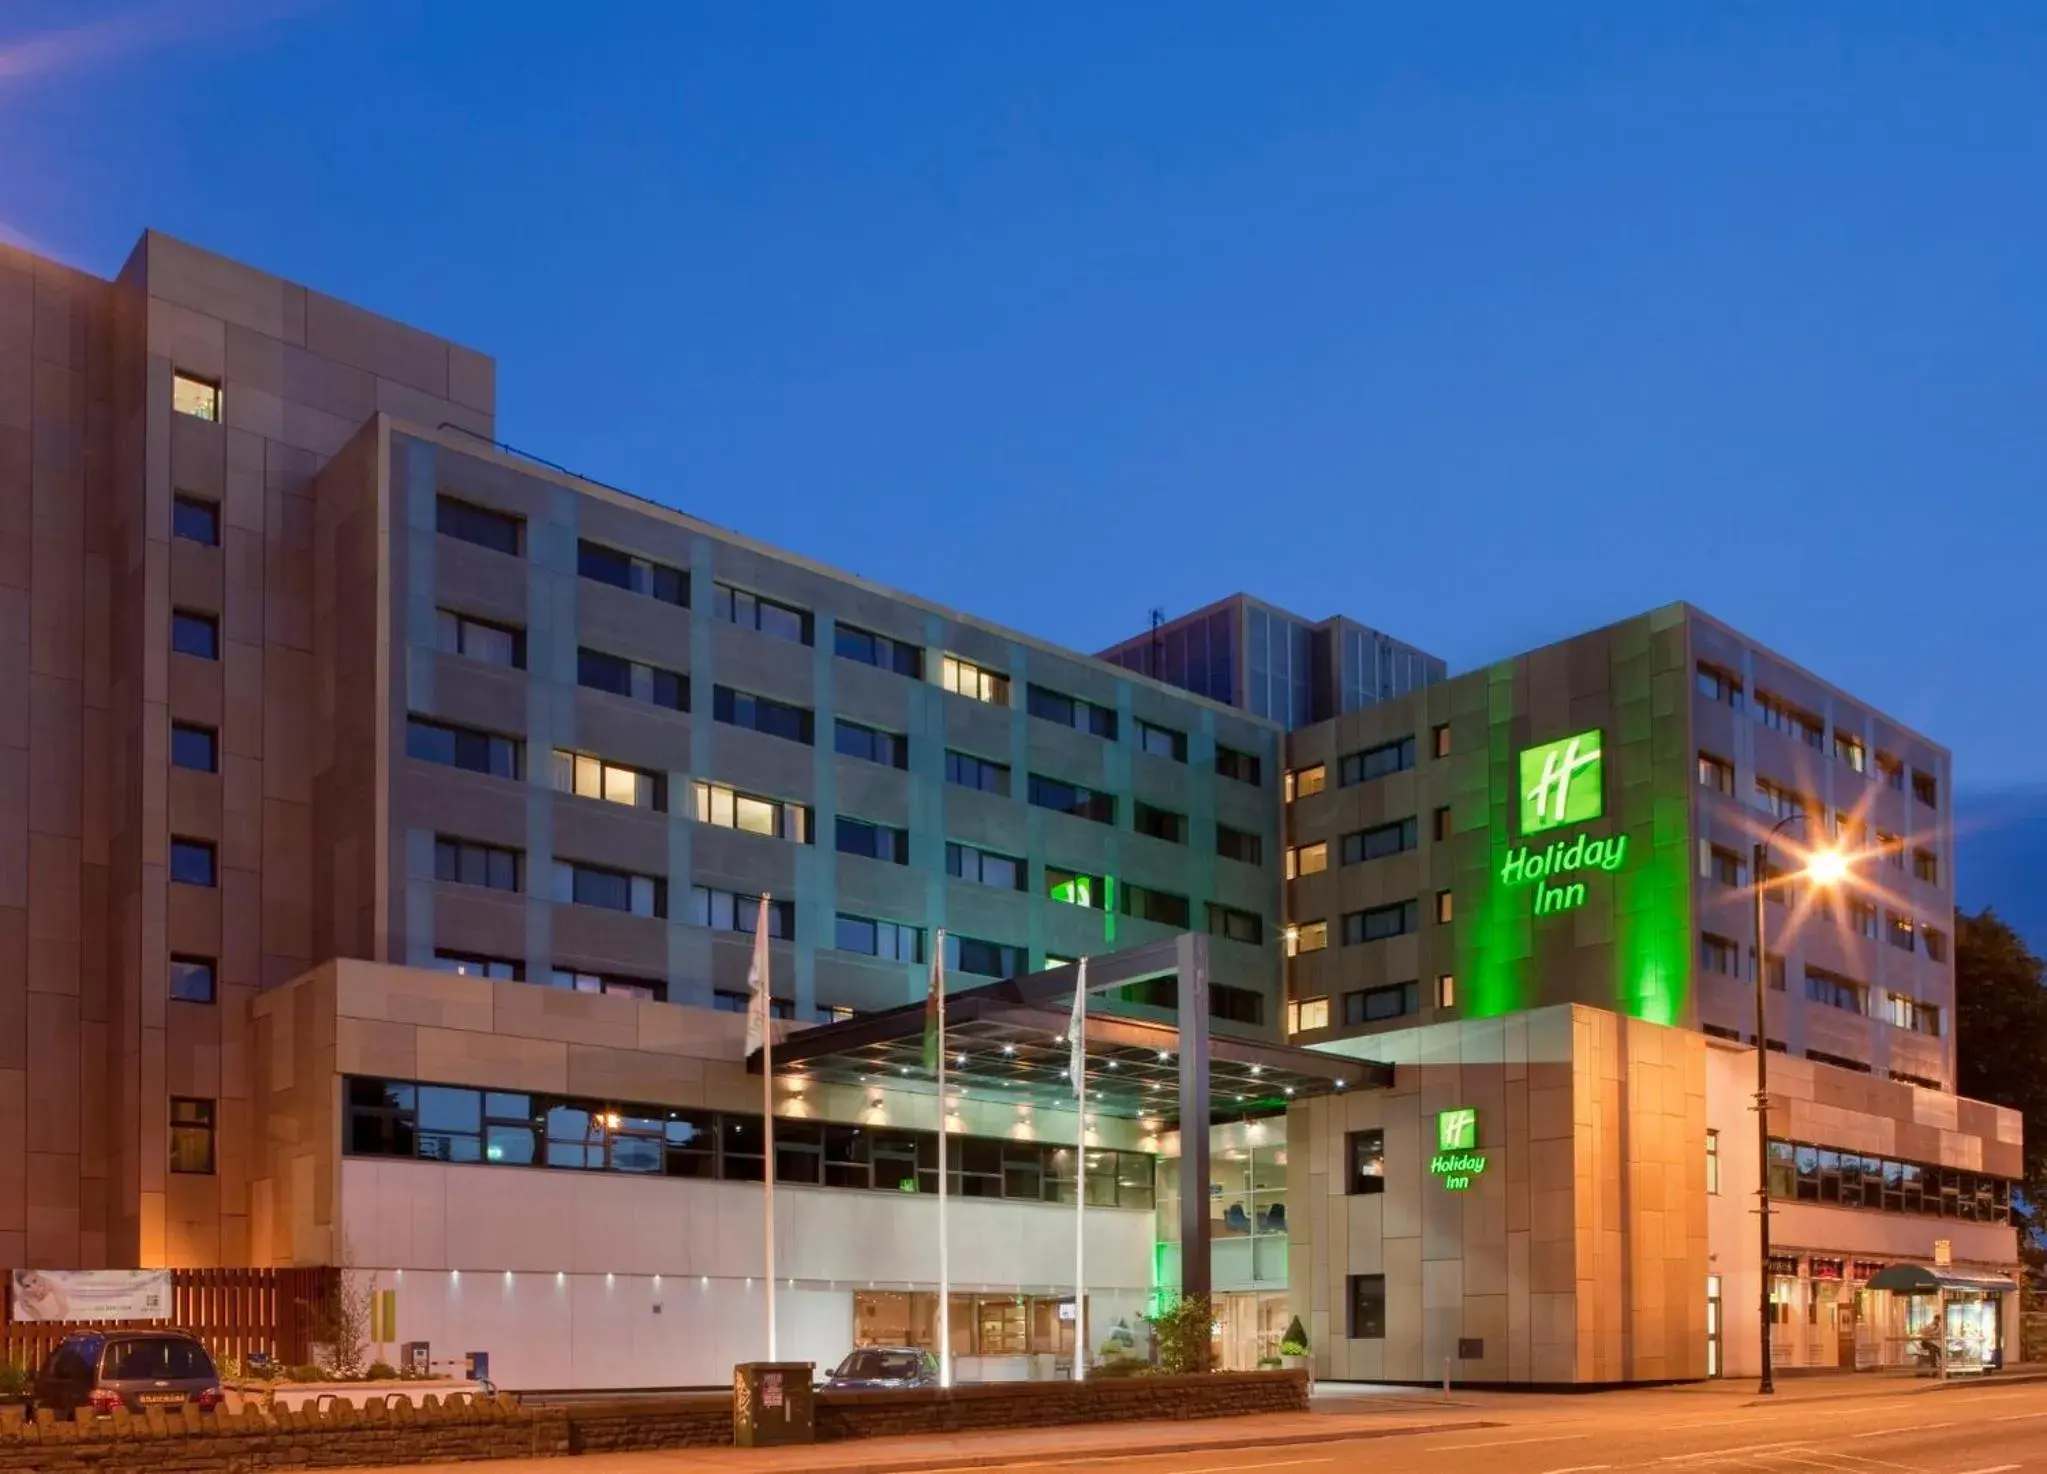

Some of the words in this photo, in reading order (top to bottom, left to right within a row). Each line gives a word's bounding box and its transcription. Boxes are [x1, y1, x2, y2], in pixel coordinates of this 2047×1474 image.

[1501, 834, 1627, 883] Holiday
[1535, 881, 1585, 915] Inn
[1431, 1154, 1485, 1173] Holiday
[1446, 1175, 1469, 1189] Inn
